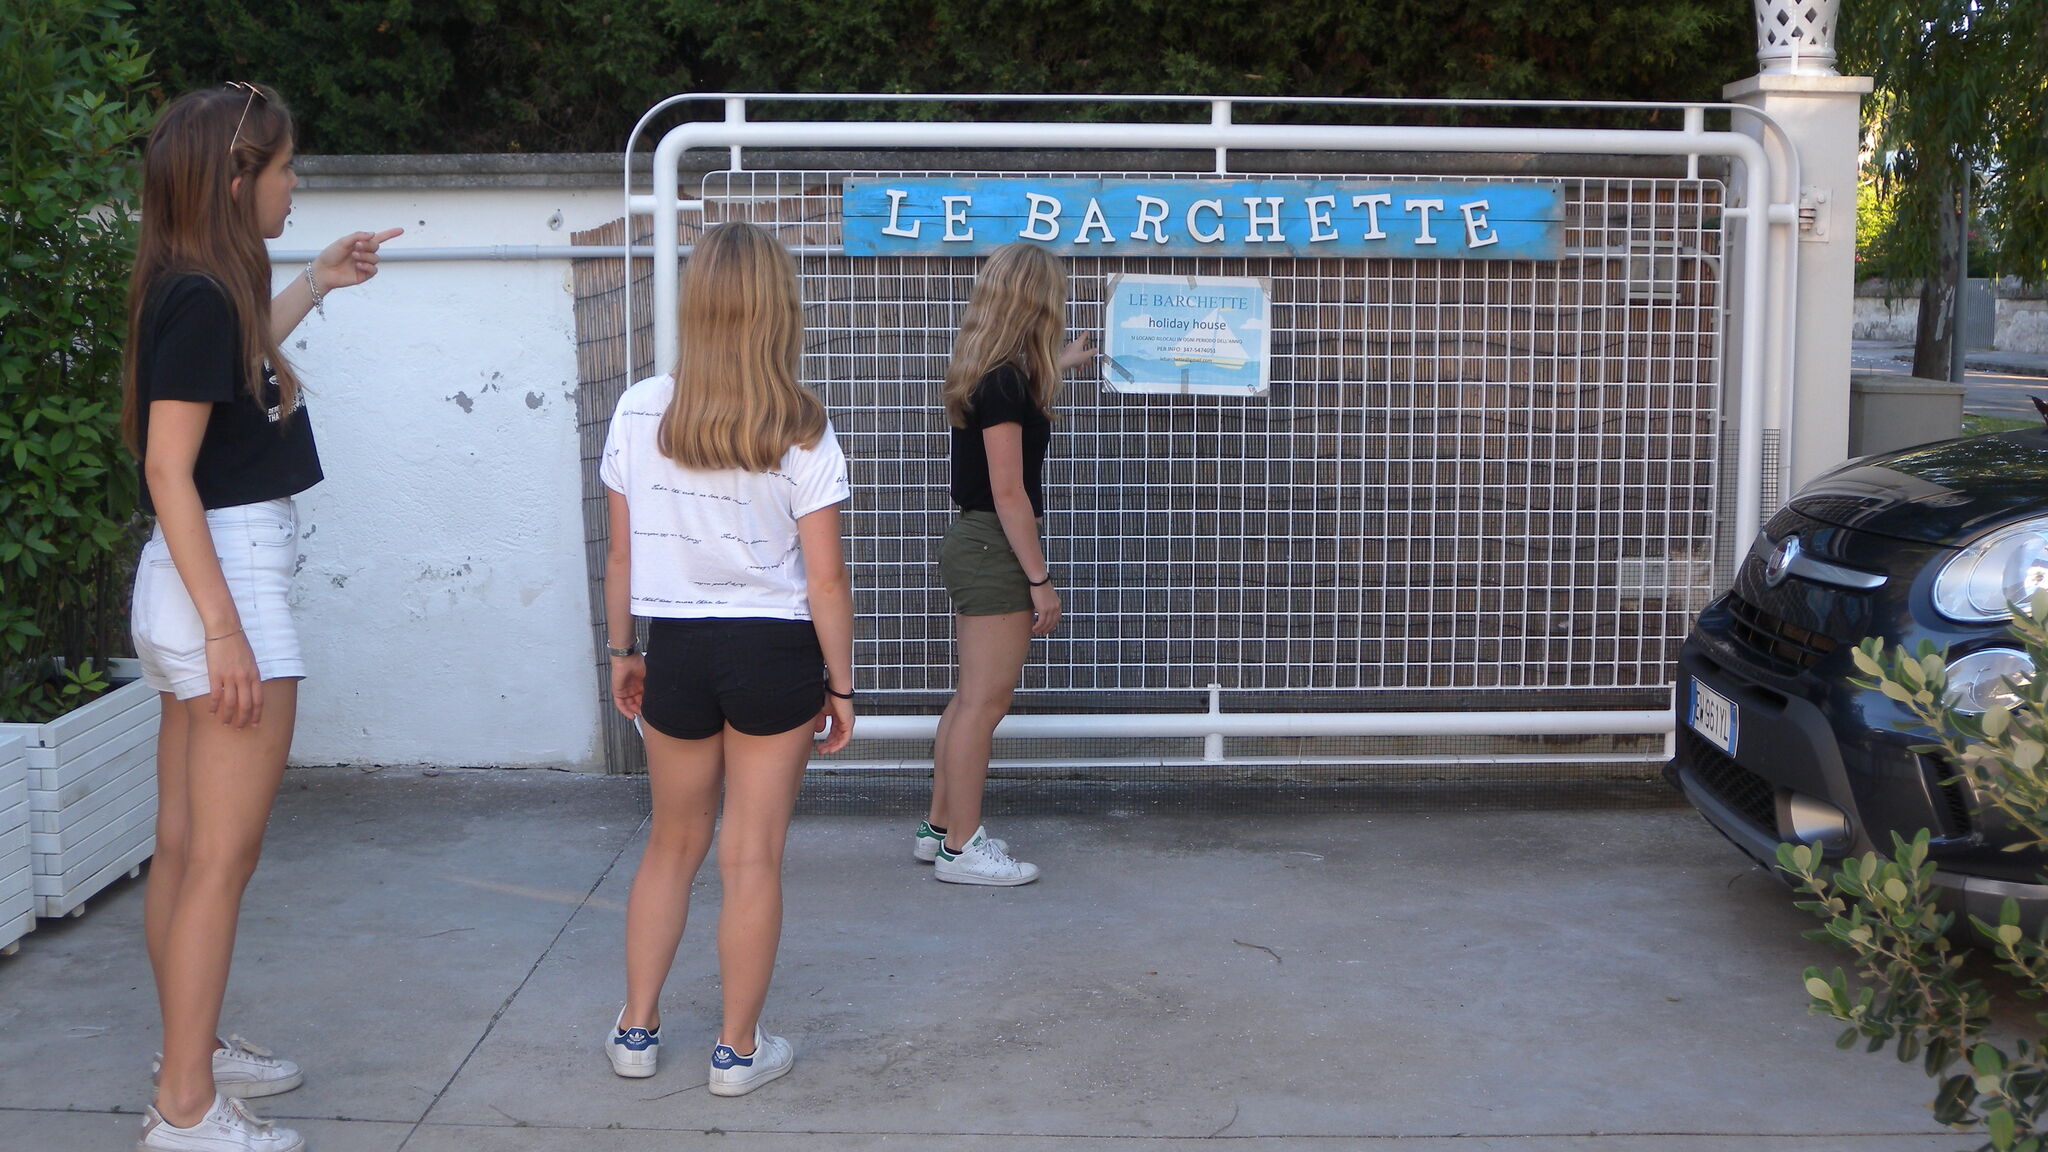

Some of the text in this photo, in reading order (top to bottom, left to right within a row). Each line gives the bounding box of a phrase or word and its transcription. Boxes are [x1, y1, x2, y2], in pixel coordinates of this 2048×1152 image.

[881, 189, 1500, 249] LE BARCHETTE
[1129, 293, 1248, 310] LE BARCHETTE
[1149, 317, 1227, 331] holiday house
